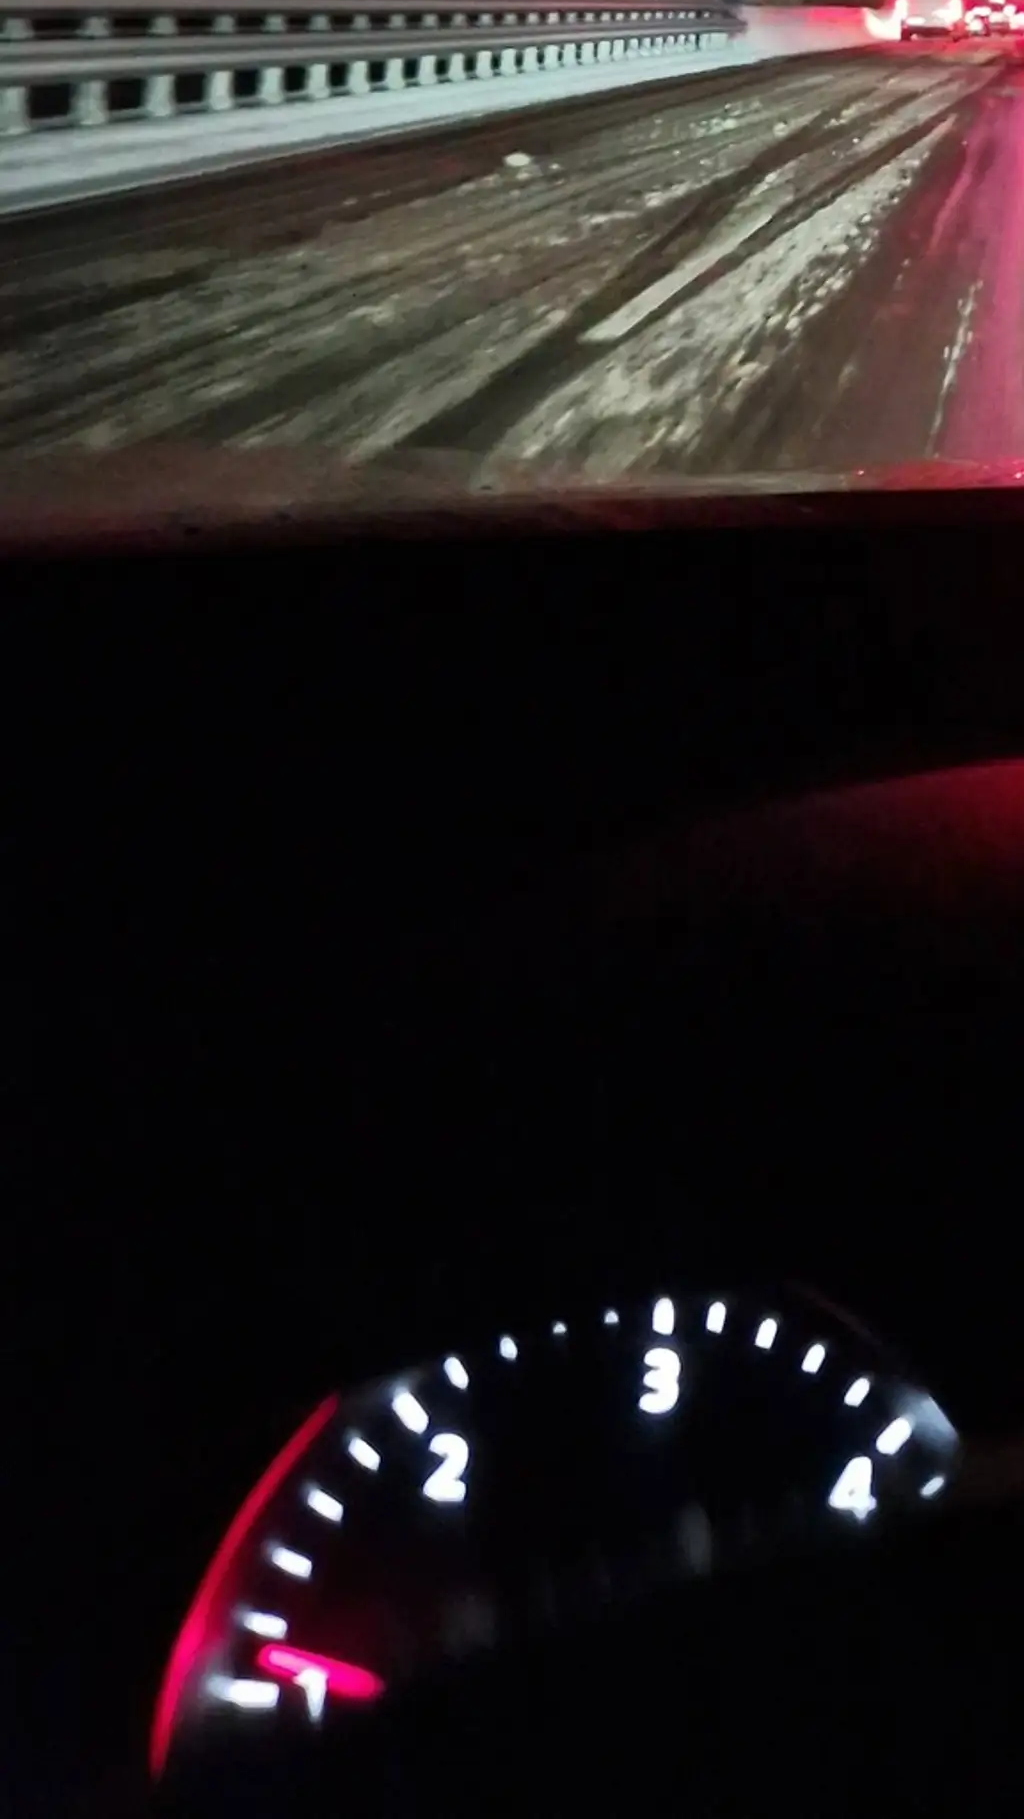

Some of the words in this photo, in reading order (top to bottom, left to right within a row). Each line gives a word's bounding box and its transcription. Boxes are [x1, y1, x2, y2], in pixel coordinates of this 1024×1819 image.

[638, 1346, 682, 1415] 3
[421, 1432, 470, 1504] 2
[828, 1455, 879, 1521] 4
[293, 1661, 330, 1721] 1
